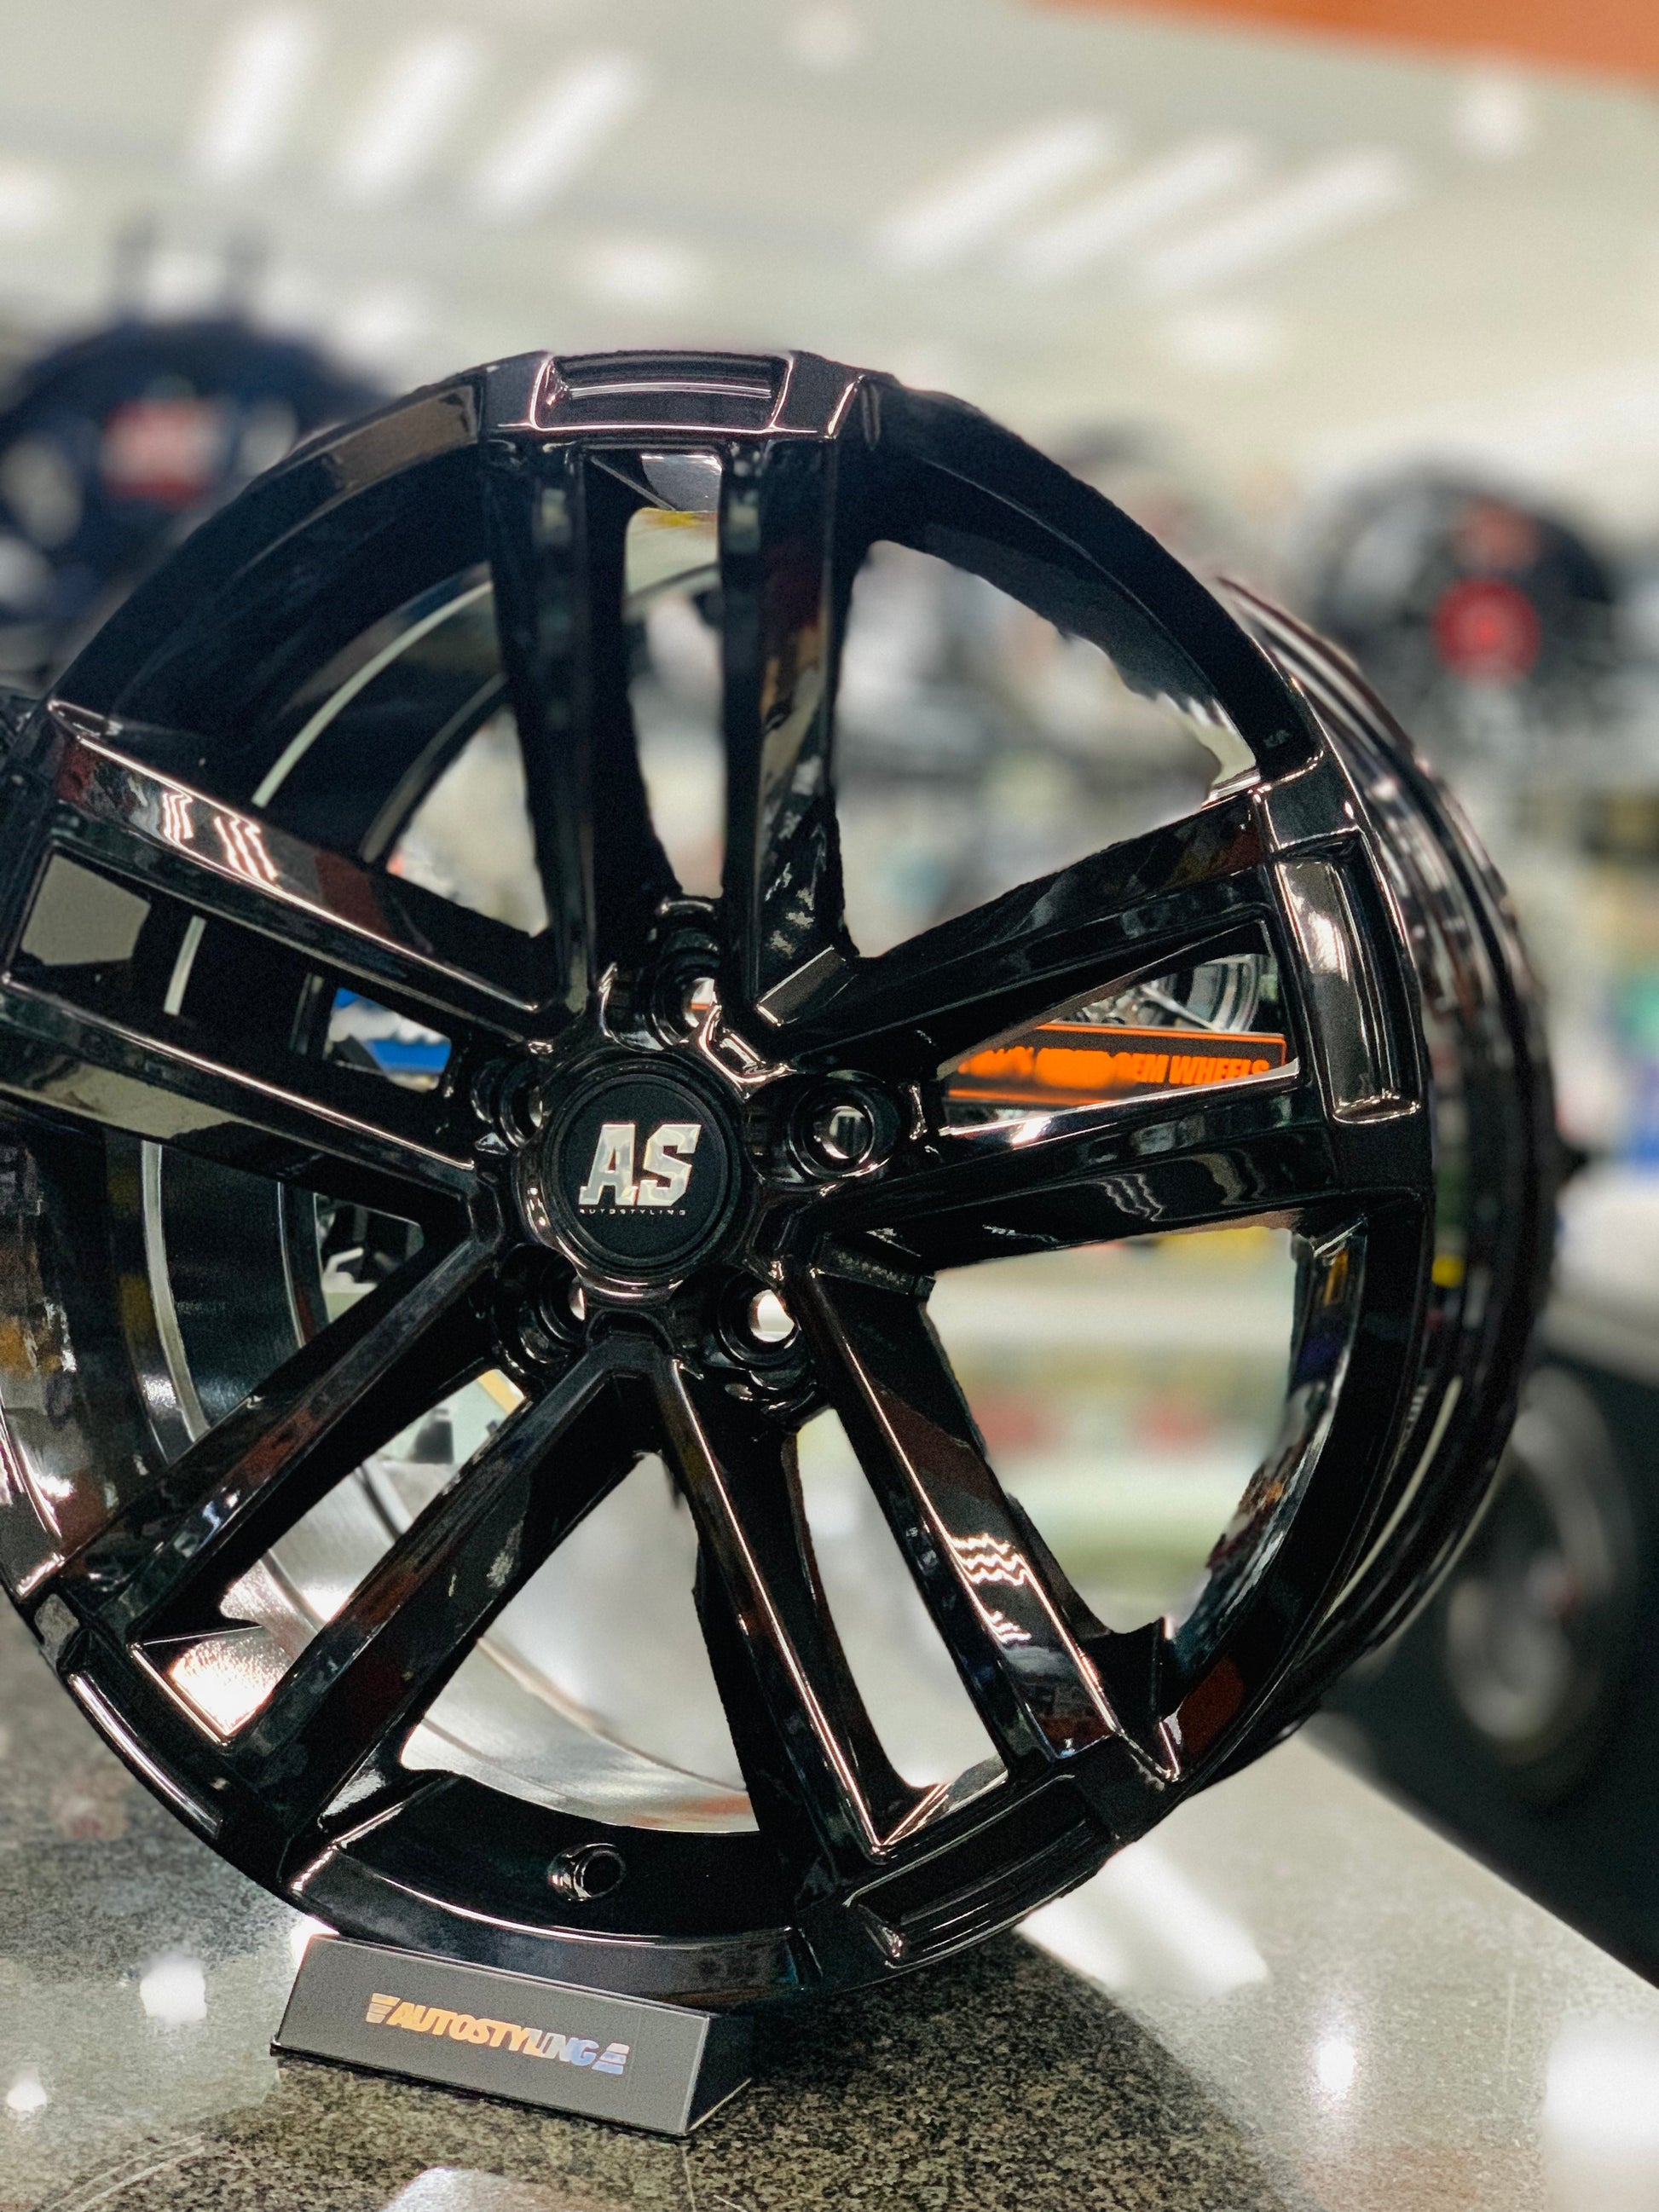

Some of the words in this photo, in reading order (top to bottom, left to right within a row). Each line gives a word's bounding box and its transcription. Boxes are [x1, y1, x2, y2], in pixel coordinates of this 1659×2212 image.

[578, 1123, 702, 1206] AS
[579, 1208, 686, 1216] AUTOSTYLING
[386, 2001, 600, 2067] AUTOSTYLING
